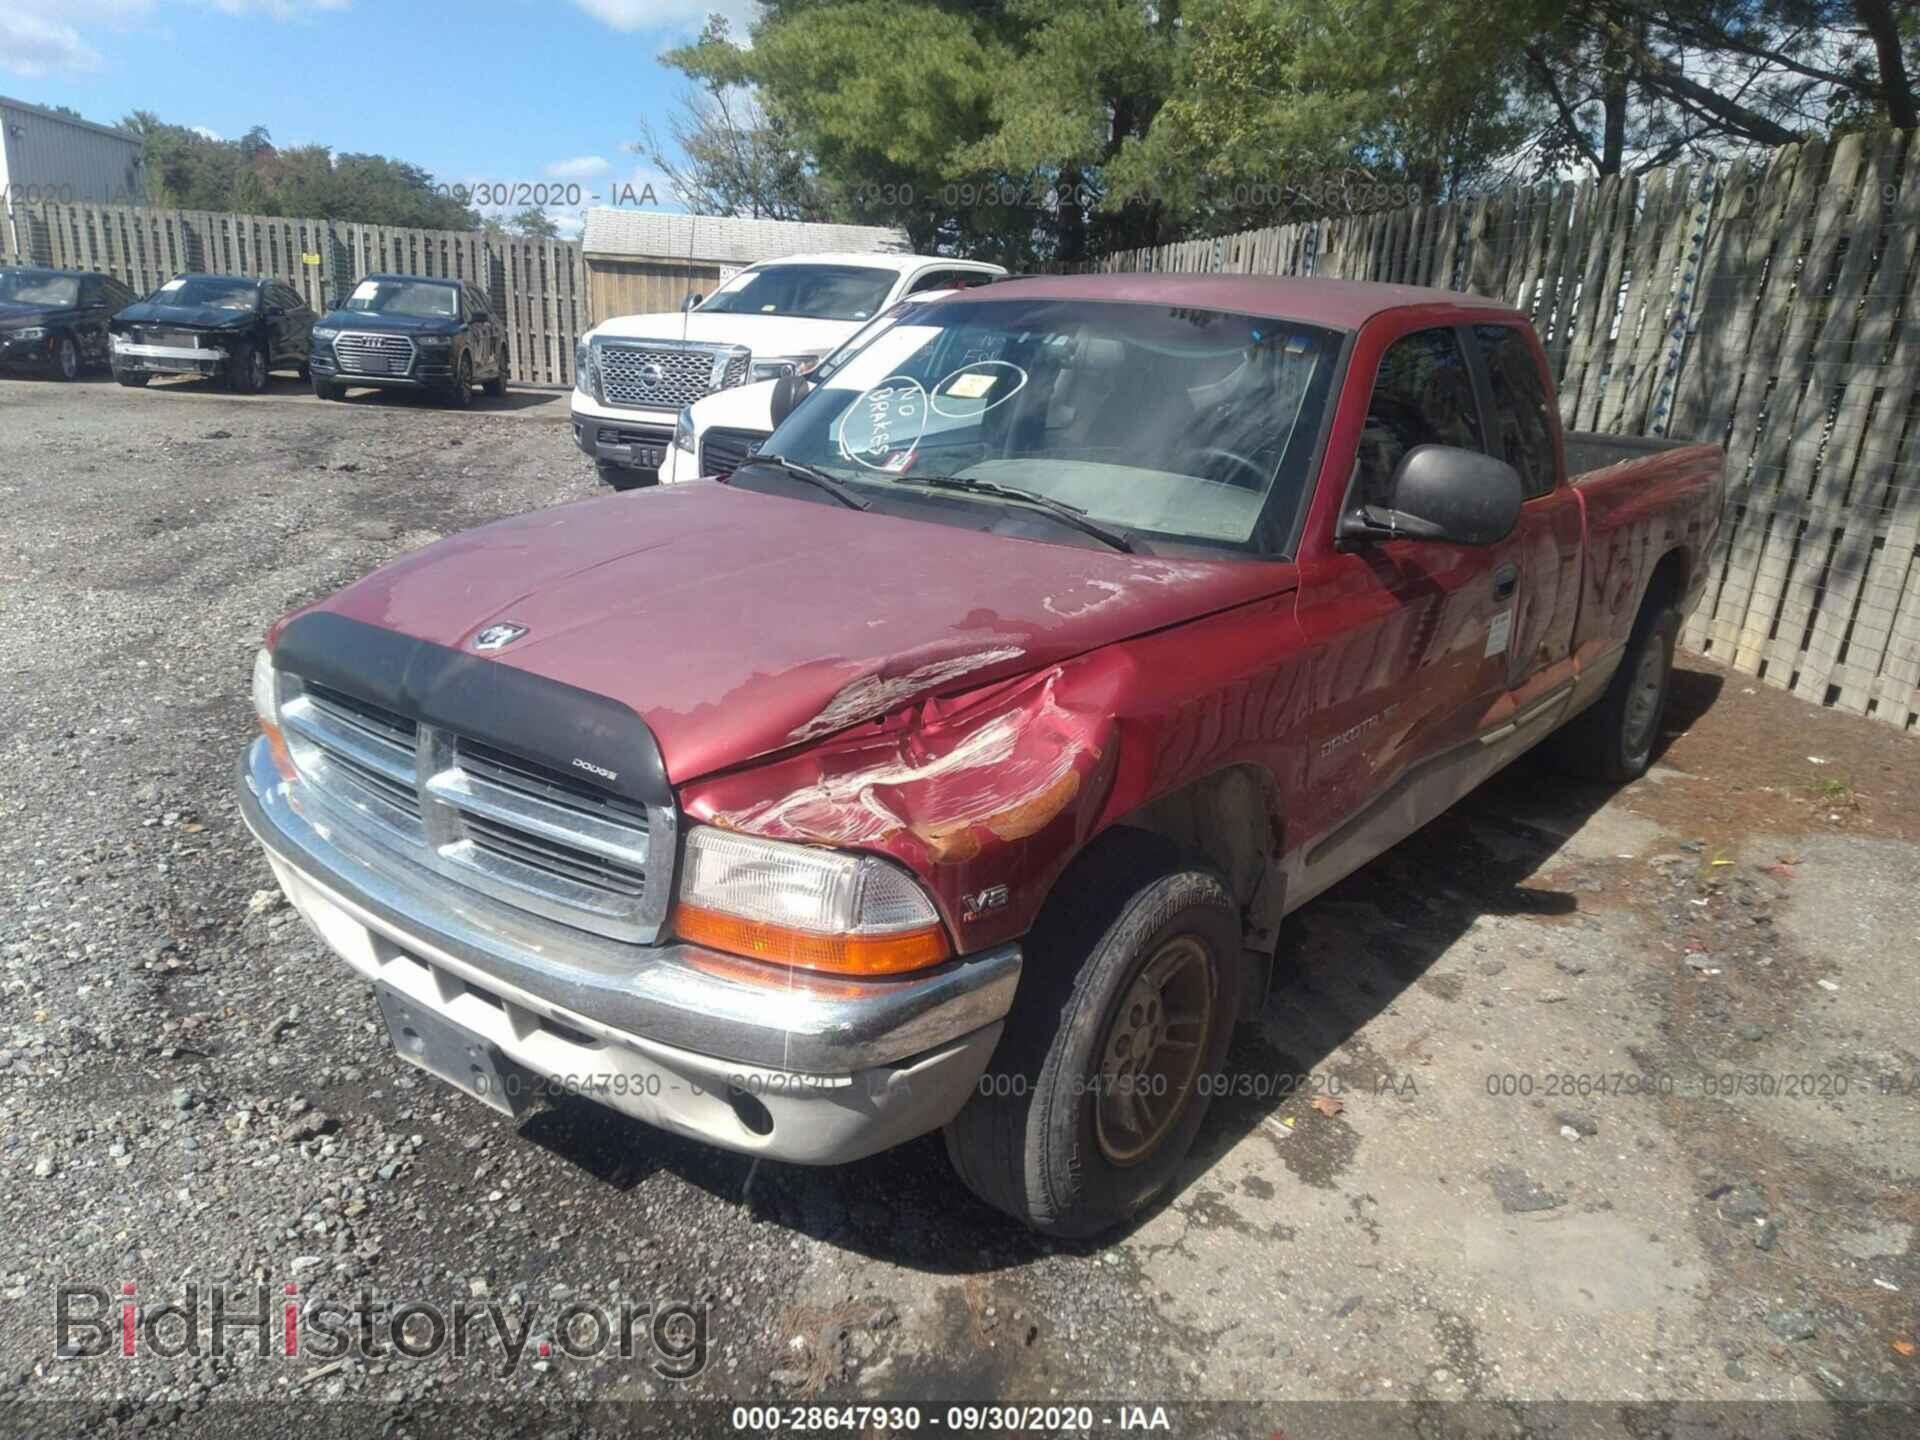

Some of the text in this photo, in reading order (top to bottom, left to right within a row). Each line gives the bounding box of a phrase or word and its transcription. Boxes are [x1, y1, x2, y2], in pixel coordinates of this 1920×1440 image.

[898, 385, 921, 417] NO
[869, 386, 894, 455] BRAKES
[572, 758, 617, 781] DODGE
